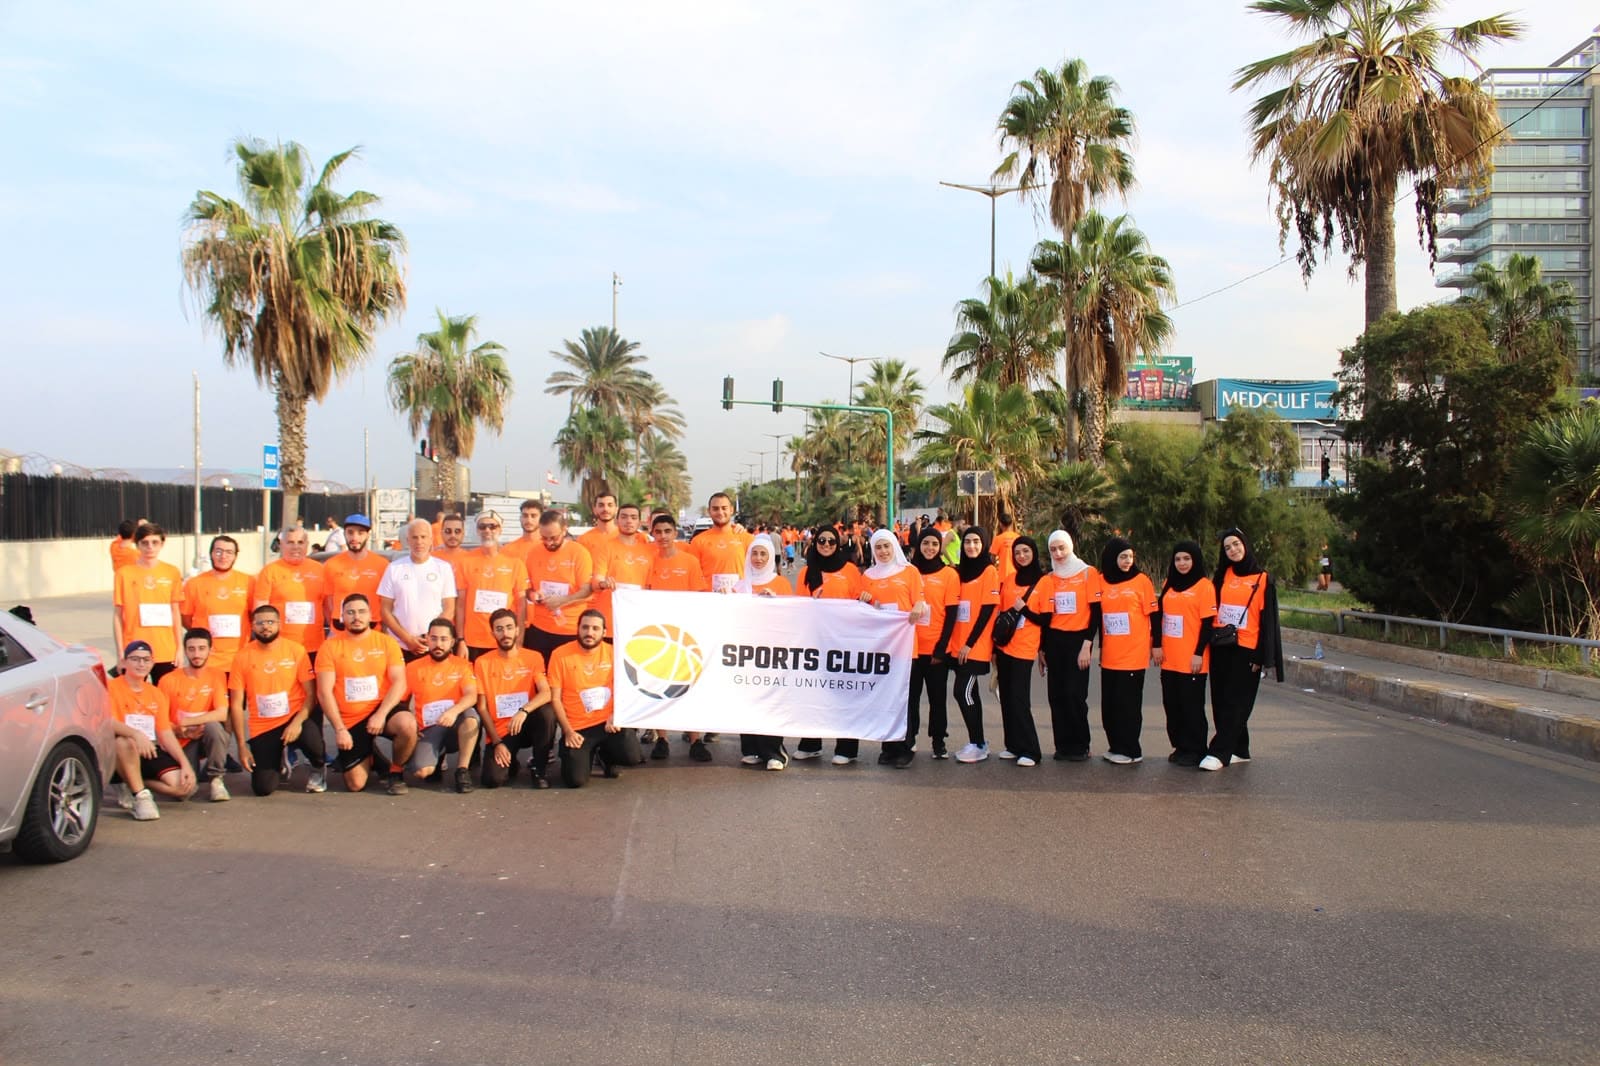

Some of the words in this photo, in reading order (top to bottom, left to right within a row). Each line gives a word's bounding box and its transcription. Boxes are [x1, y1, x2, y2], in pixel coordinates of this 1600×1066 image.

[1222, 390, 1310, 409] MEDGULF
[722, 644, 820, 671] SPORTS
[826, 649, 891, 676] CLUB
[733, 674, 788, 688] GLOBAL
[795, 675, 877, 692] UNIVERSITY
